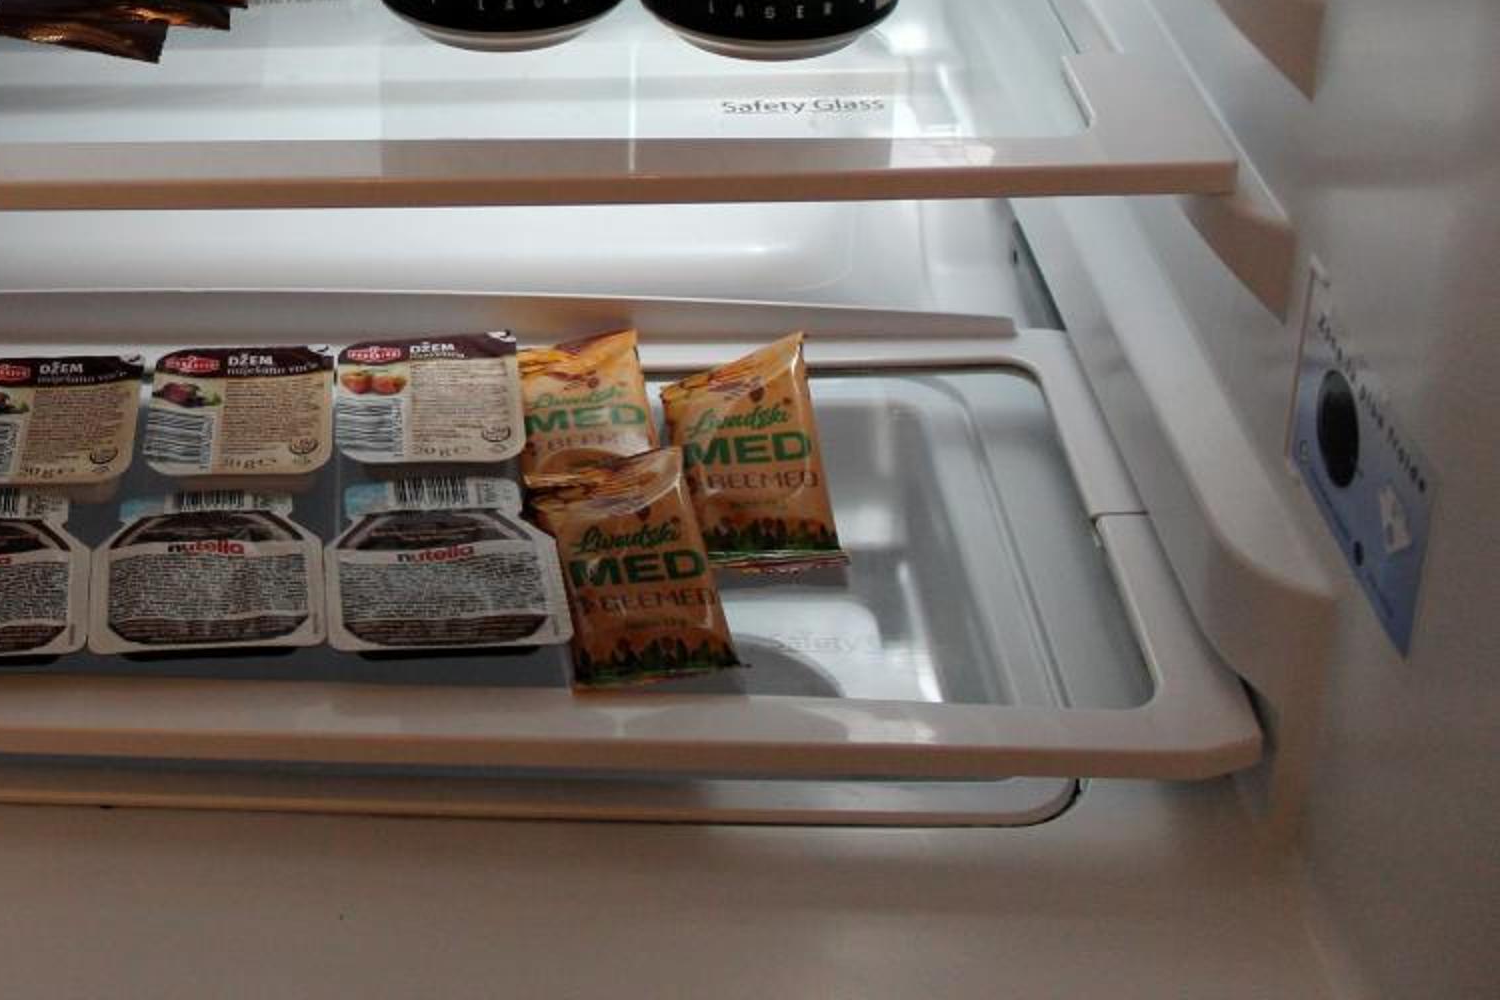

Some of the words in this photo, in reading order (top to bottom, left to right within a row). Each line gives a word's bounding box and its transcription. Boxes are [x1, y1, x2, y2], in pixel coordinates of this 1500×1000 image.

[722, 99, 808, 115] Safety
[812, 97, 885, 112] Glass
[409, 341, 456, 353] DŽEM
[39, 361, 85, 375] DŽEM
[227, 353, 274, 367] DŽEM
[522, 403, 647, 435] MED
[682, 430, 812, 468] MED
[167, 538, 245, 555] nutella
[397, 543, 475, 562] nutella
[568, 548, 707, 588] MED
